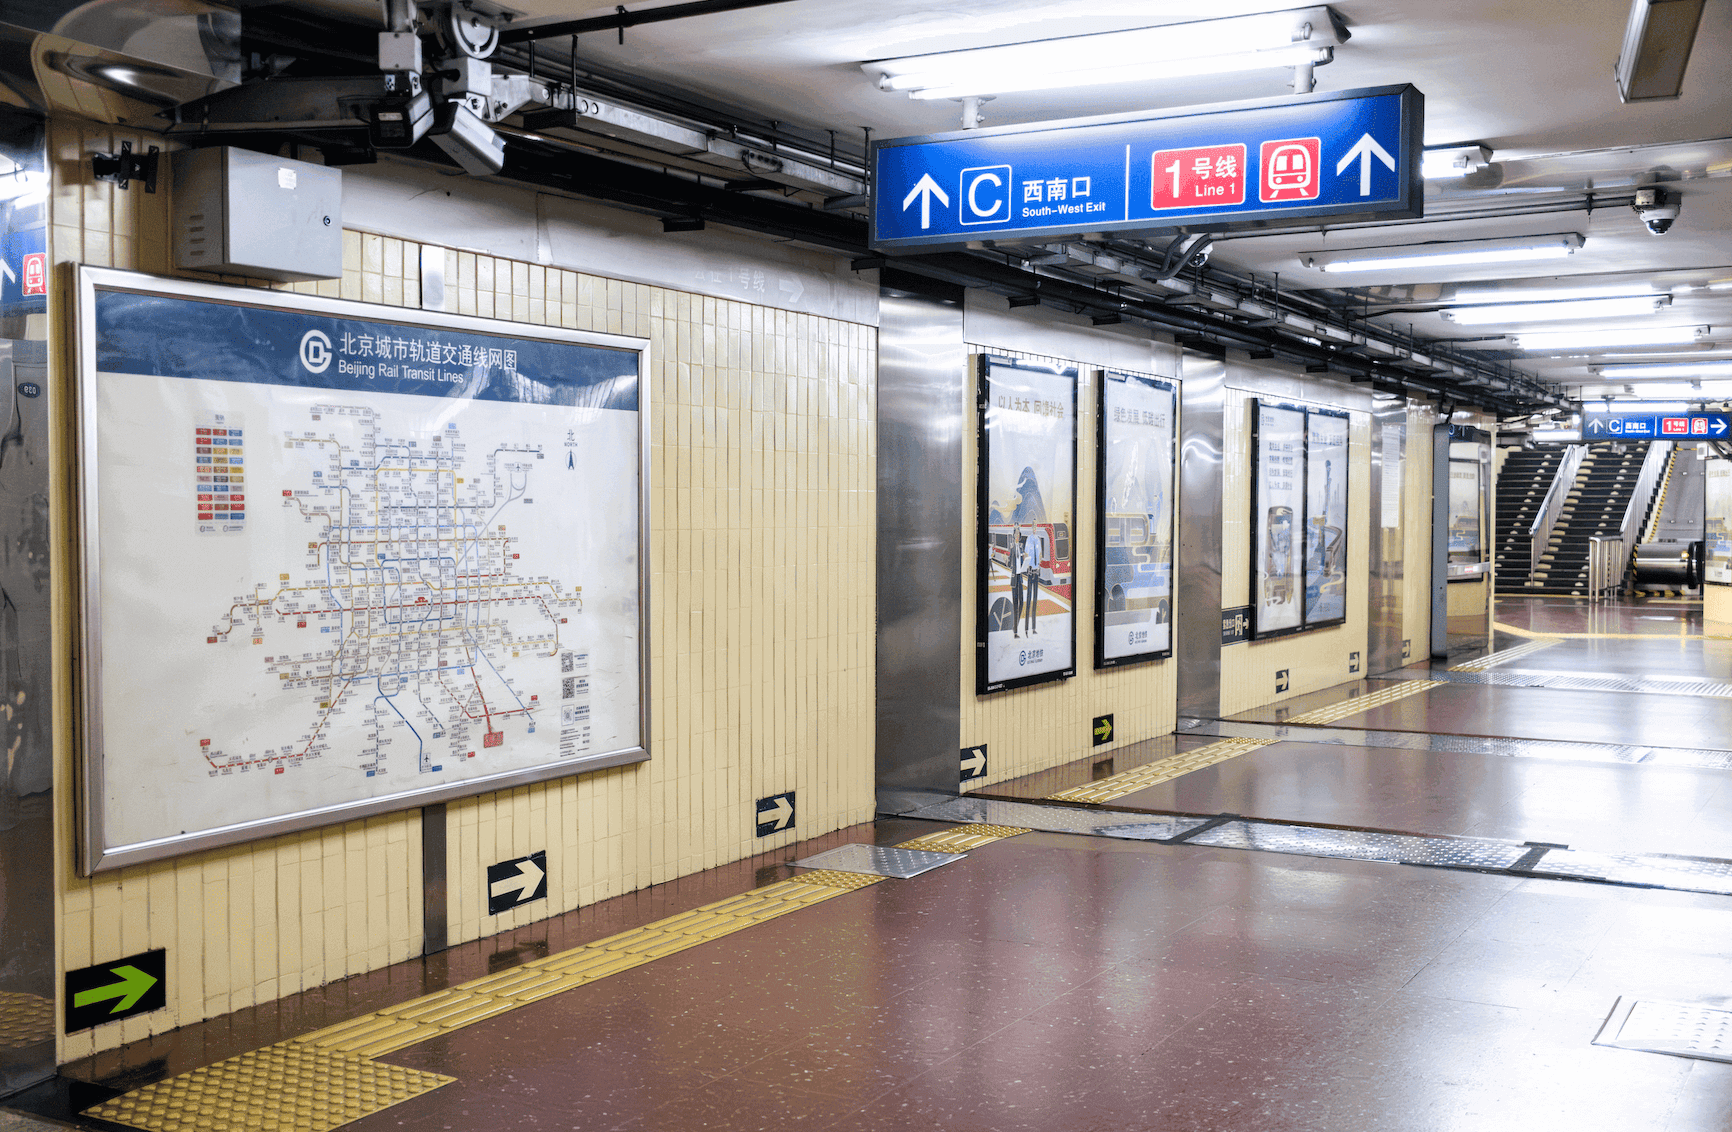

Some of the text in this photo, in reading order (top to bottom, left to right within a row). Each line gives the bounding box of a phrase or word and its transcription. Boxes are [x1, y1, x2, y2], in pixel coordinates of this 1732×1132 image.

[1165, 155, 1237, 198] 1 号线
[968, 173, 1002, 217] C
[1022, 176, 1091, 203] 西南口
[1195, 182, 1235, 197] Line 1
[1022, 201, 1106, 217] South-West Exit
[339, 332, 518, 371] 北京城市轨道交通线网图
[338, 360, 464, 384] Beijing Rail Transit Lines
[998, 395, 1065, 419] 以人为本 回馈社会
[567, 429, 576, 442] 北
[1608, 419, 1620, 432] C
[1625, 422, 1646, 430] 西南口
